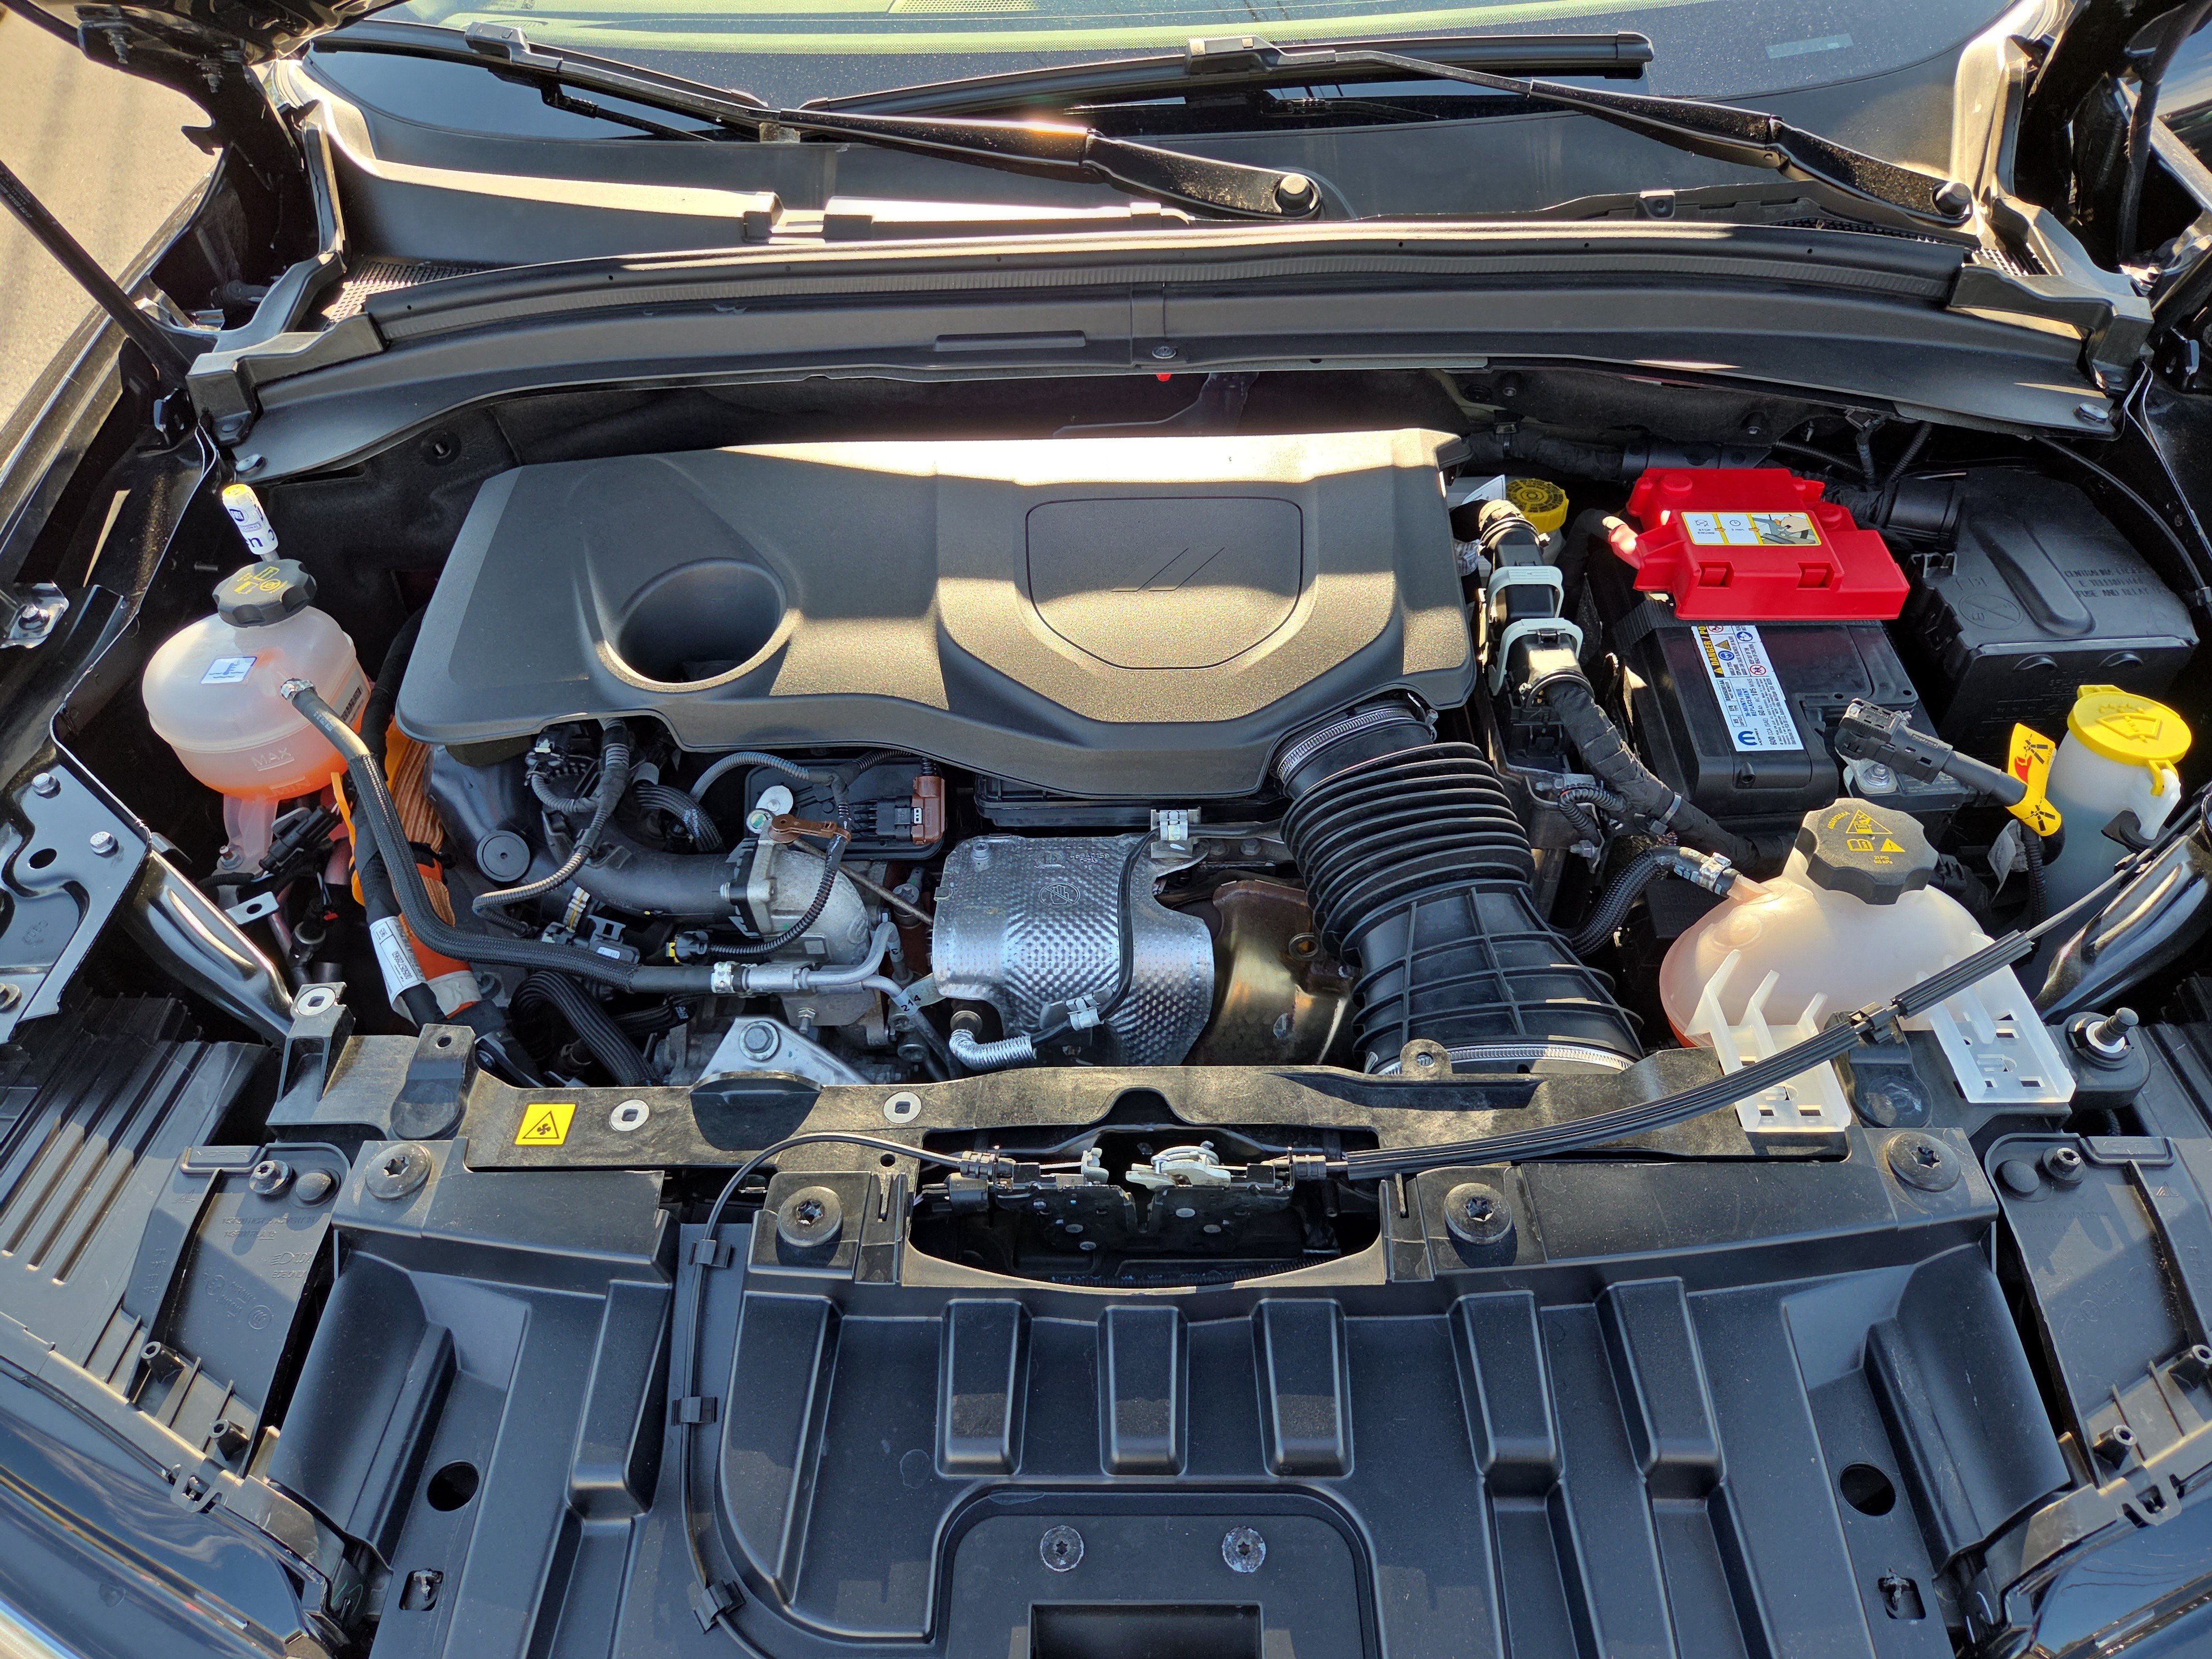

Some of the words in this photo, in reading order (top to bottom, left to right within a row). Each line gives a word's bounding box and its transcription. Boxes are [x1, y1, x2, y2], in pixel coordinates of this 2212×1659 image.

[2102, 589, 2119, 597] AND
[1703, 640, 1720, 665] DANGER
[1741, 688, 1757, 716] REPLACEMENT
[1767, 736, 1777, 744] 600
[251, 748, 291, 766] MAX
[274, 780, 311, 795] MIN
[901, 994, 921, 1012] 214
